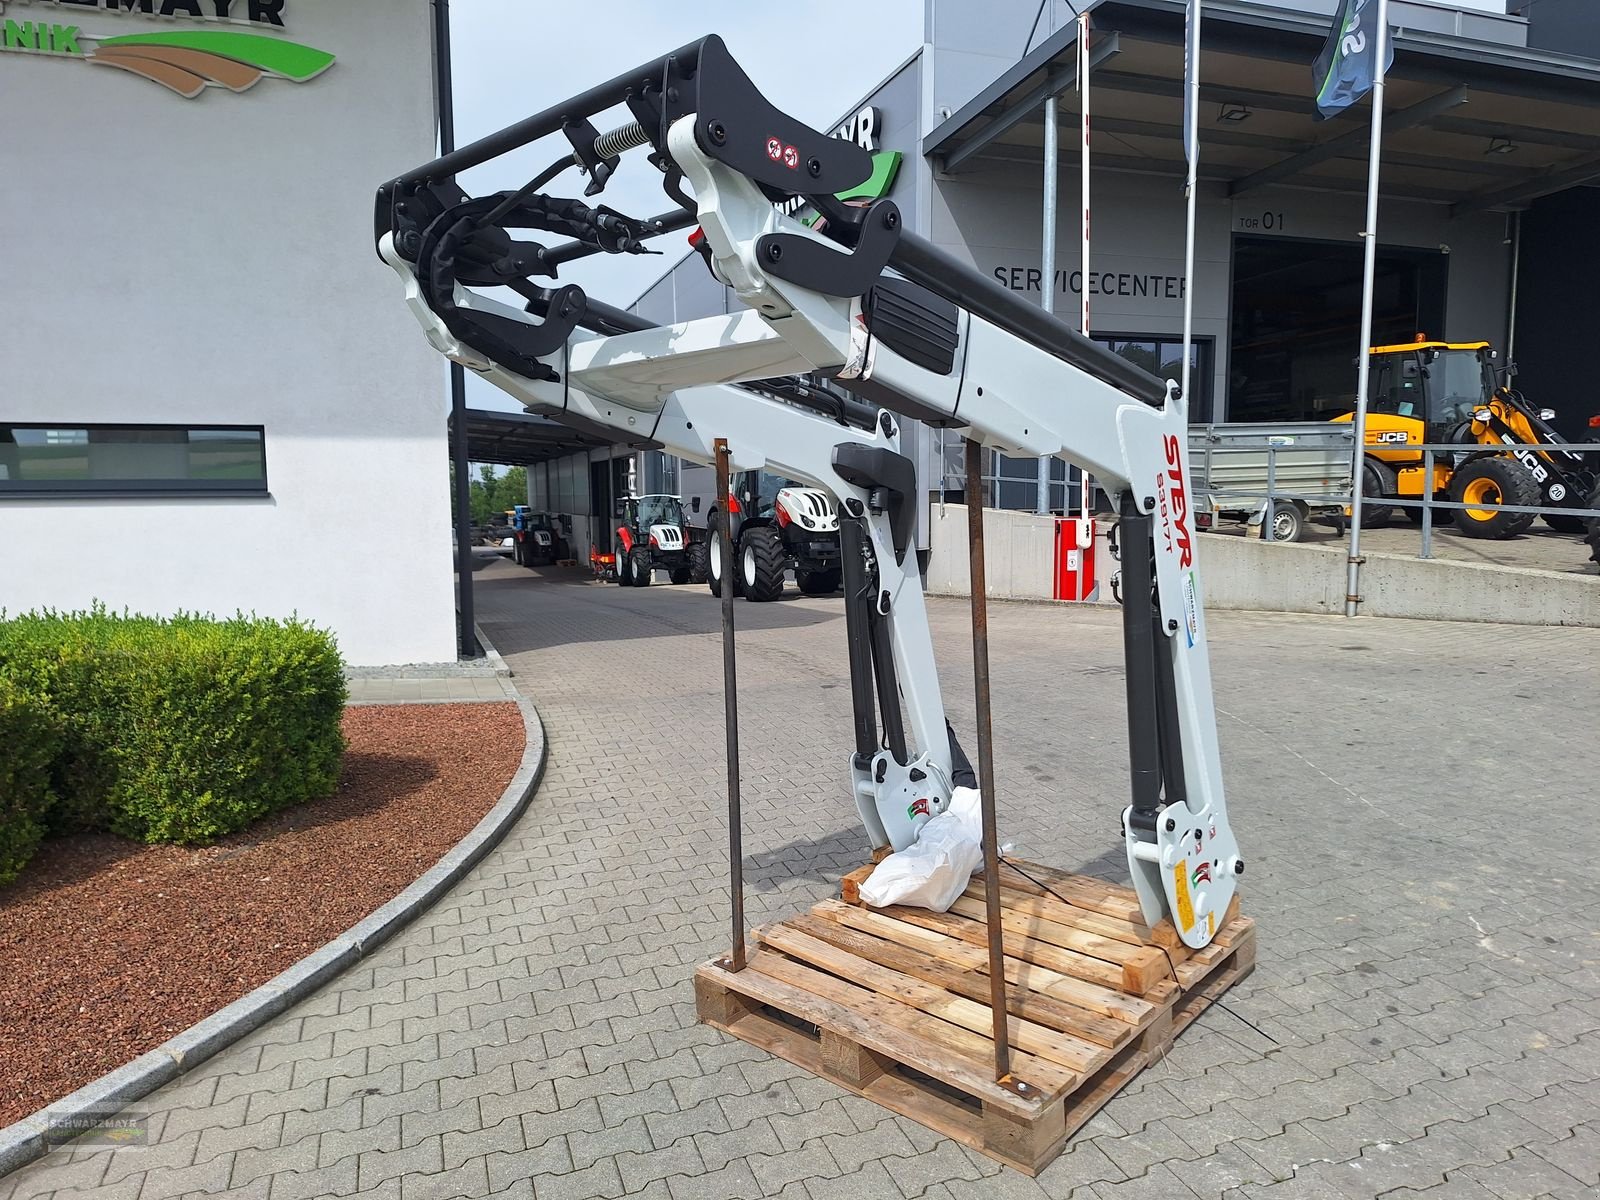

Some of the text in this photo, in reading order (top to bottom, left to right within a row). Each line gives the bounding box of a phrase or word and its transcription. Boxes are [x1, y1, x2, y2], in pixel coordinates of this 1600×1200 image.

[1239, 211, 1284, 231] TOR 01
[1377, 432, 1408, 443] JCB
[1551, 486, 1563, 498] 20
[1163, 433, 1192, 571] STEYR
